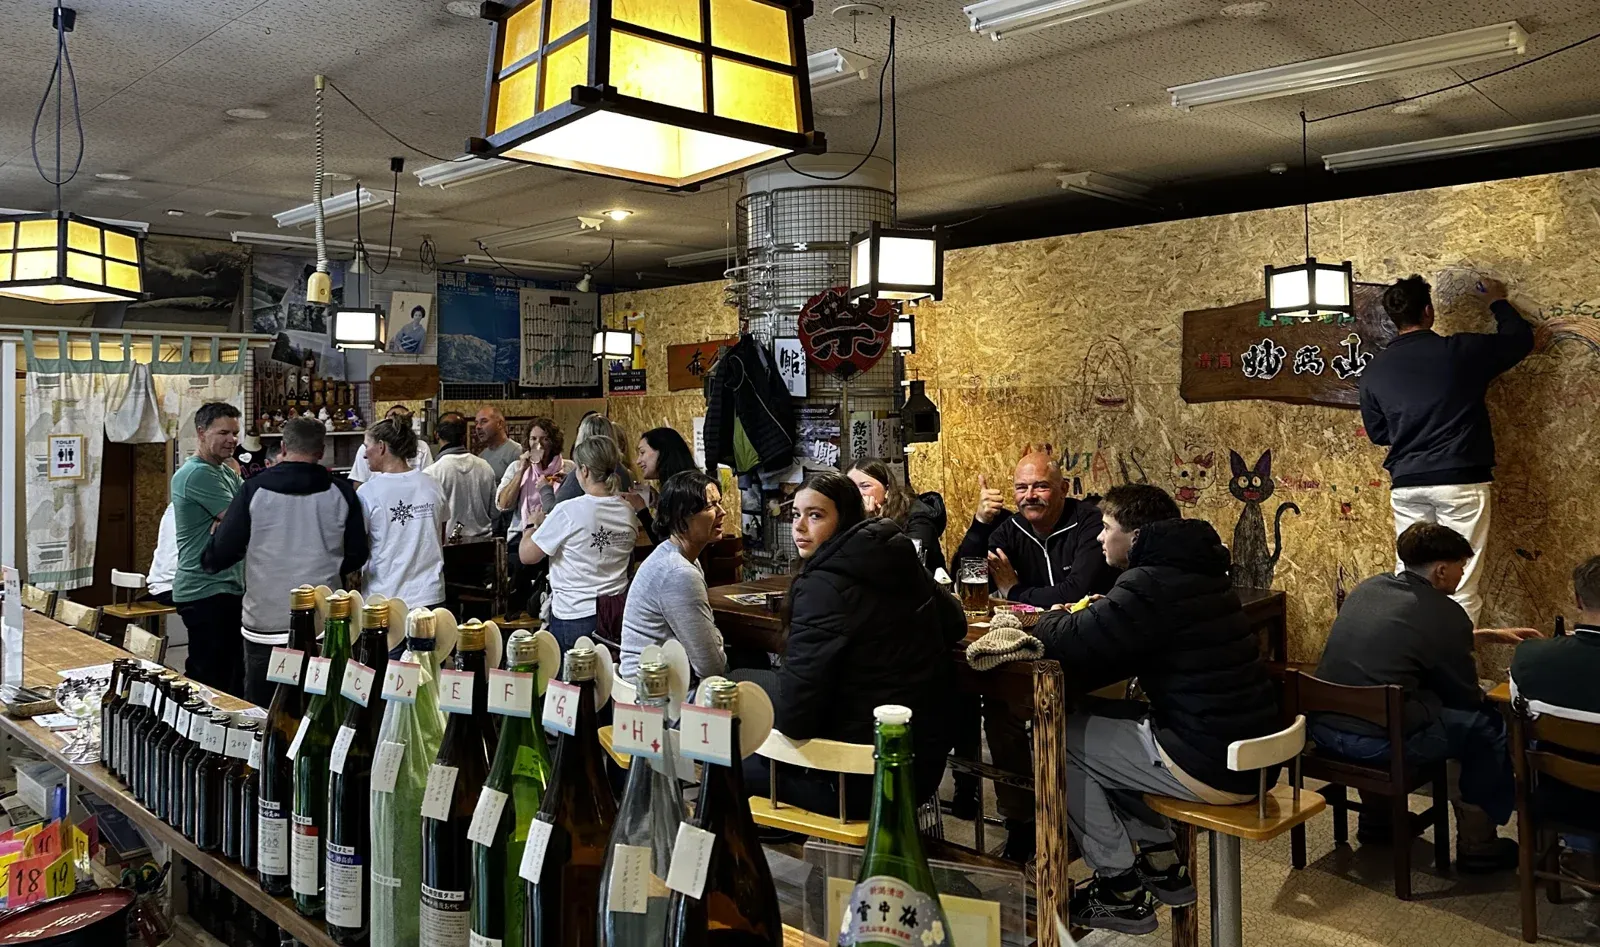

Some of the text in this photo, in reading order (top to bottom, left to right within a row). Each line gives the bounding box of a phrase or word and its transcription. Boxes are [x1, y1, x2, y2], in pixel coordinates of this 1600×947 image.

[1240, 334, 1374, 380] 妙高山
[275, 658, 286, 674] A
[354, 678, 361, 690] C
[396, 675, 404, 691] D
[452, 682, 461, 700] E
[504, 683, 514, 702] F
[556, 695, 567, 718] G
[632, 720, 644, 742] H
[16, 868, 41, 897] 18
[53, 862, 69, 897] 19
[857, 900, 919, 929] 雪中梅
